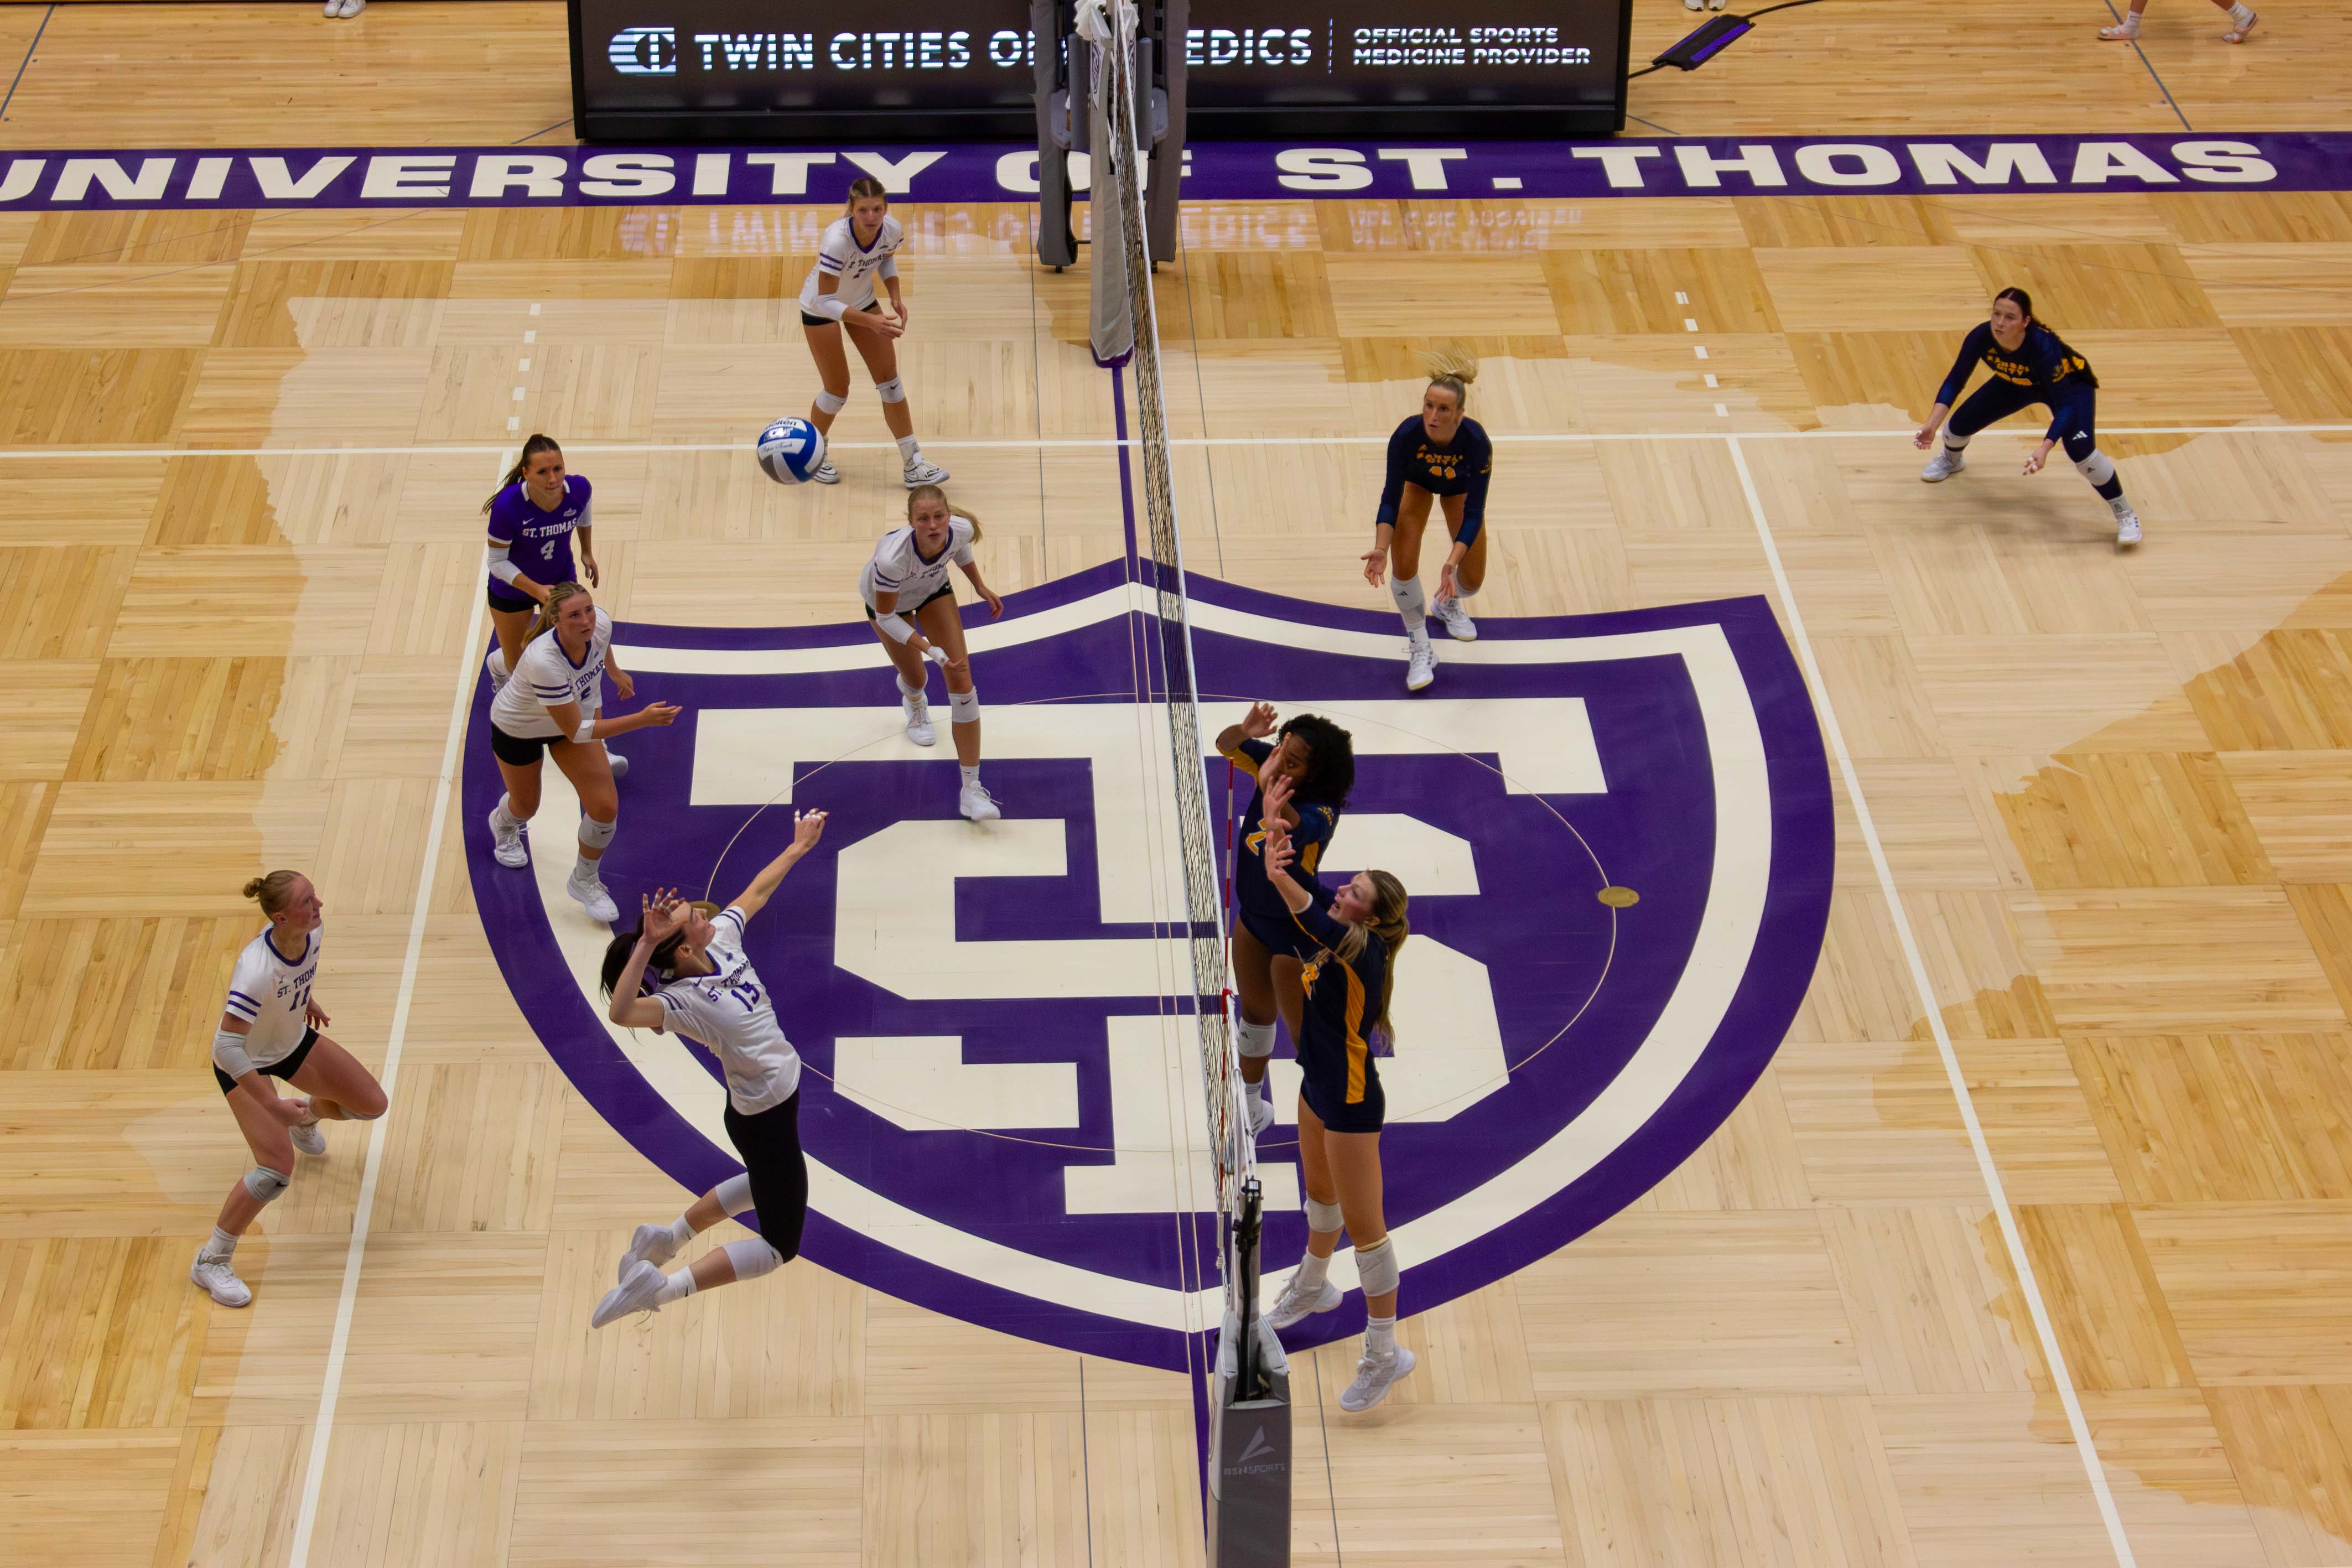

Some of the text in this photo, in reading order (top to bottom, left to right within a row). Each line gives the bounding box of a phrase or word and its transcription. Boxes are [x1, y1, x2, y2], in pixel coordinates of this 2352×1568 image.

[1353, 27, 1559, 45] OFFICIAL SPORTS
[693, 33, 814, 70] TWIN
[829, 30, 971, 70] CITIES
[988, 28, 1312, 68] OEDICS
[1353, 48, 1591, 66] MEDICINE PROVIDER
[1275, 148, 1523, 190] ST.
[1571, 141, 2278, 188] THOMAS
[858, 254, 885, 267] THOMA
[522, 517, 577, 538] ST. THOMAS
[541, 540, 555, 560] 4
[277, 985, 292, 999] ST.
[289, 984, 311, 1012] 11
